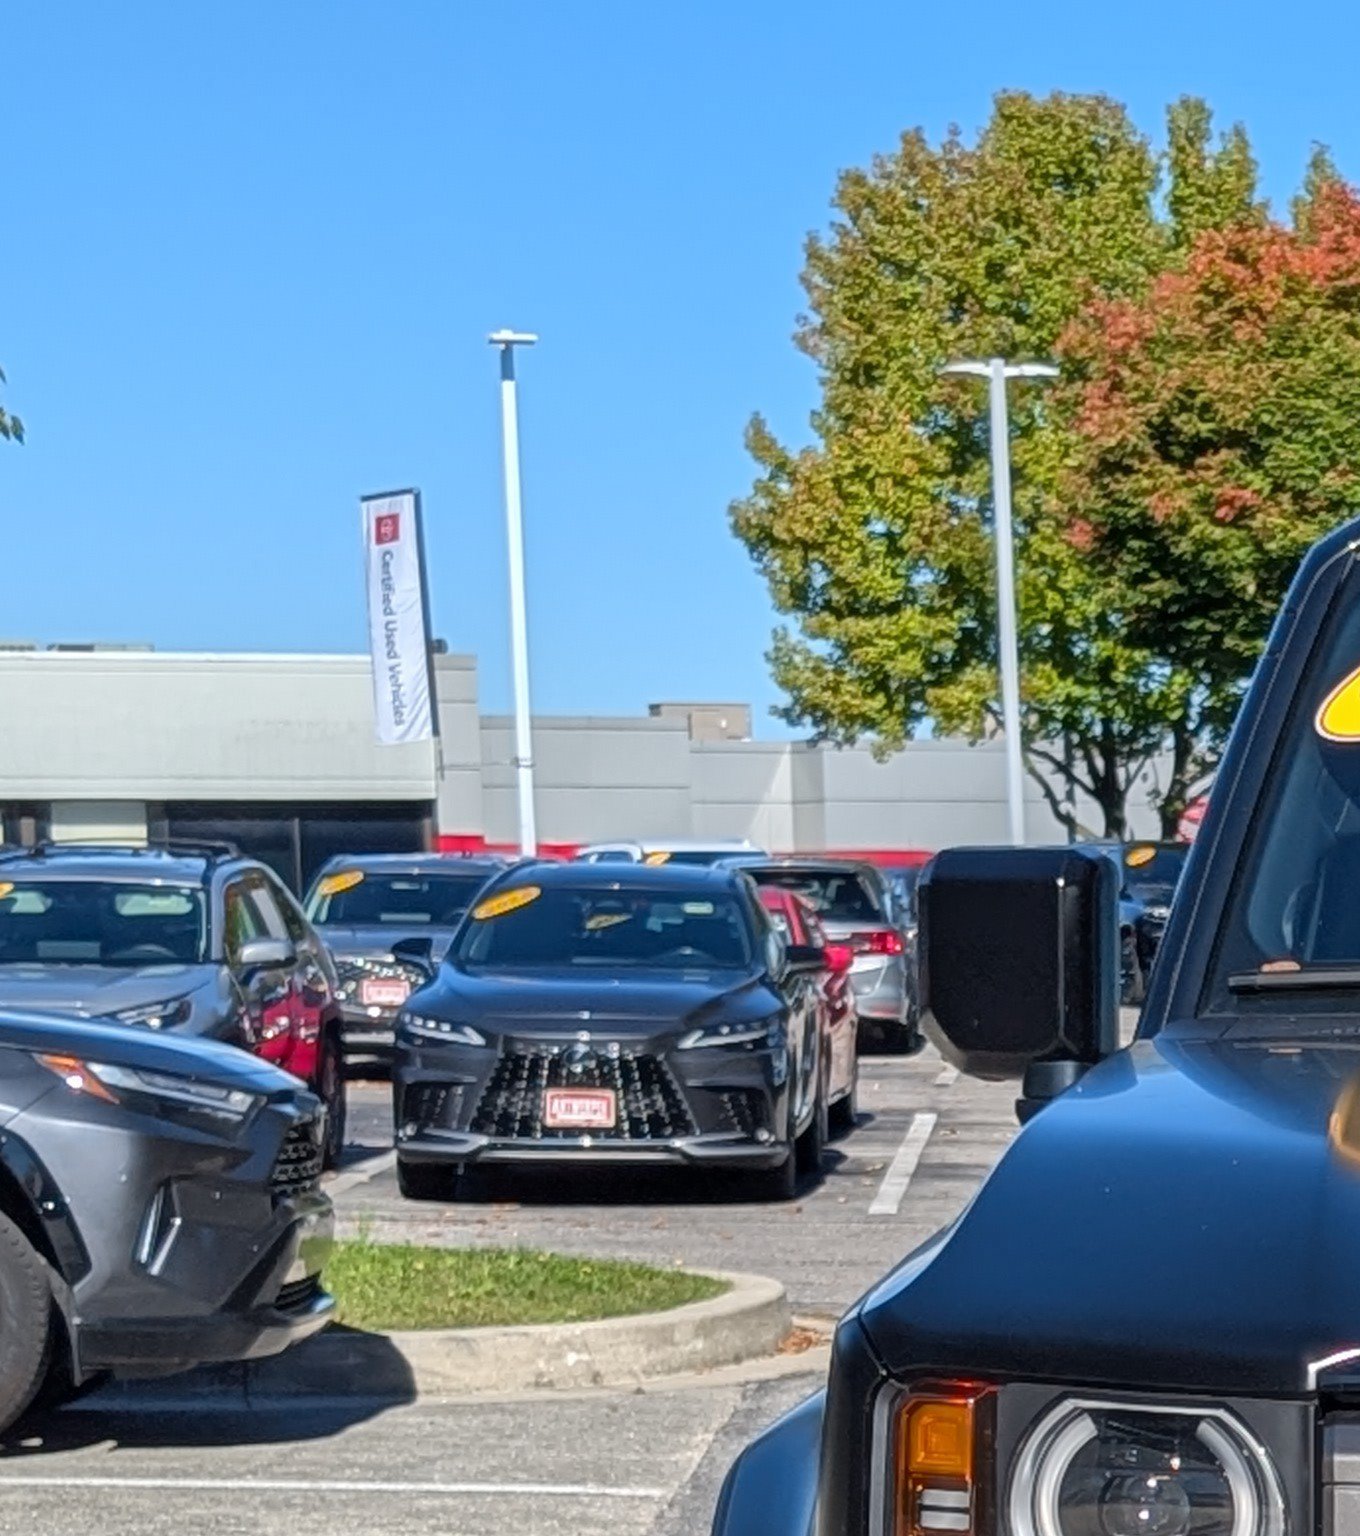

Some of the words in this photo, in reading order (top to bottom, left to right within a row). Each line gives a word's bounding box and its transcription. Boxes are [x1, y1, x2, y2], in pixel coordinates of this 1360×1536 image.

[381, 550, 397, 616] Certified
[384, 620, 400, 660] Used
[388, 663, 407, 726] Vehicles
